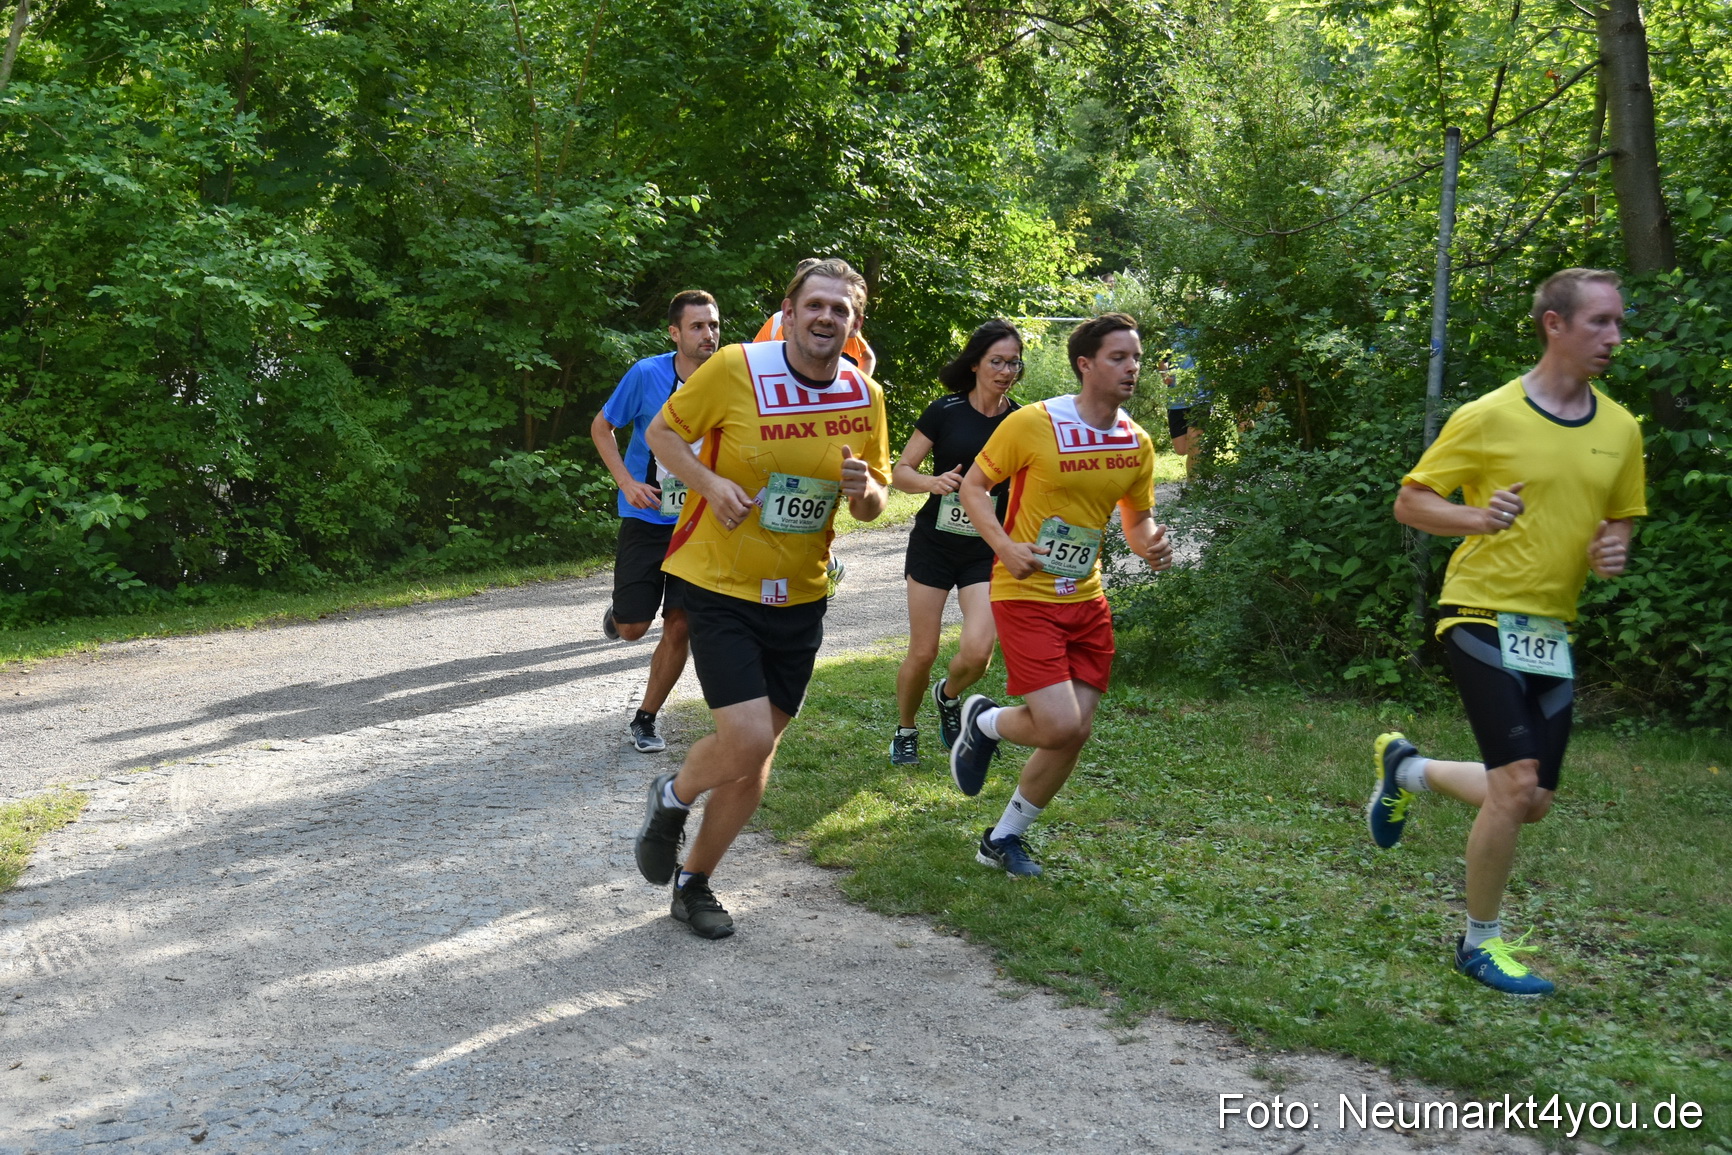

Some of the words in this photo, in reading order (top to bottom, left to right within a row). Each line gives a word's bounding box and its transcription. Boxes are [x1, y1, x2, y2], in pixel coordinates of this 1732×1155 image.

[759, 422, 818, 441] MAX
[824, 415, 872, 437] BÖGL
[1060, 458, 1101, 473] MAX
[1106, 454, 1141, 470] BÖGL
[775, 495, 827, 519] 1696
[1045, 540, 1091, 564] 1578
[1507, 633, 1558, 660] 2187
